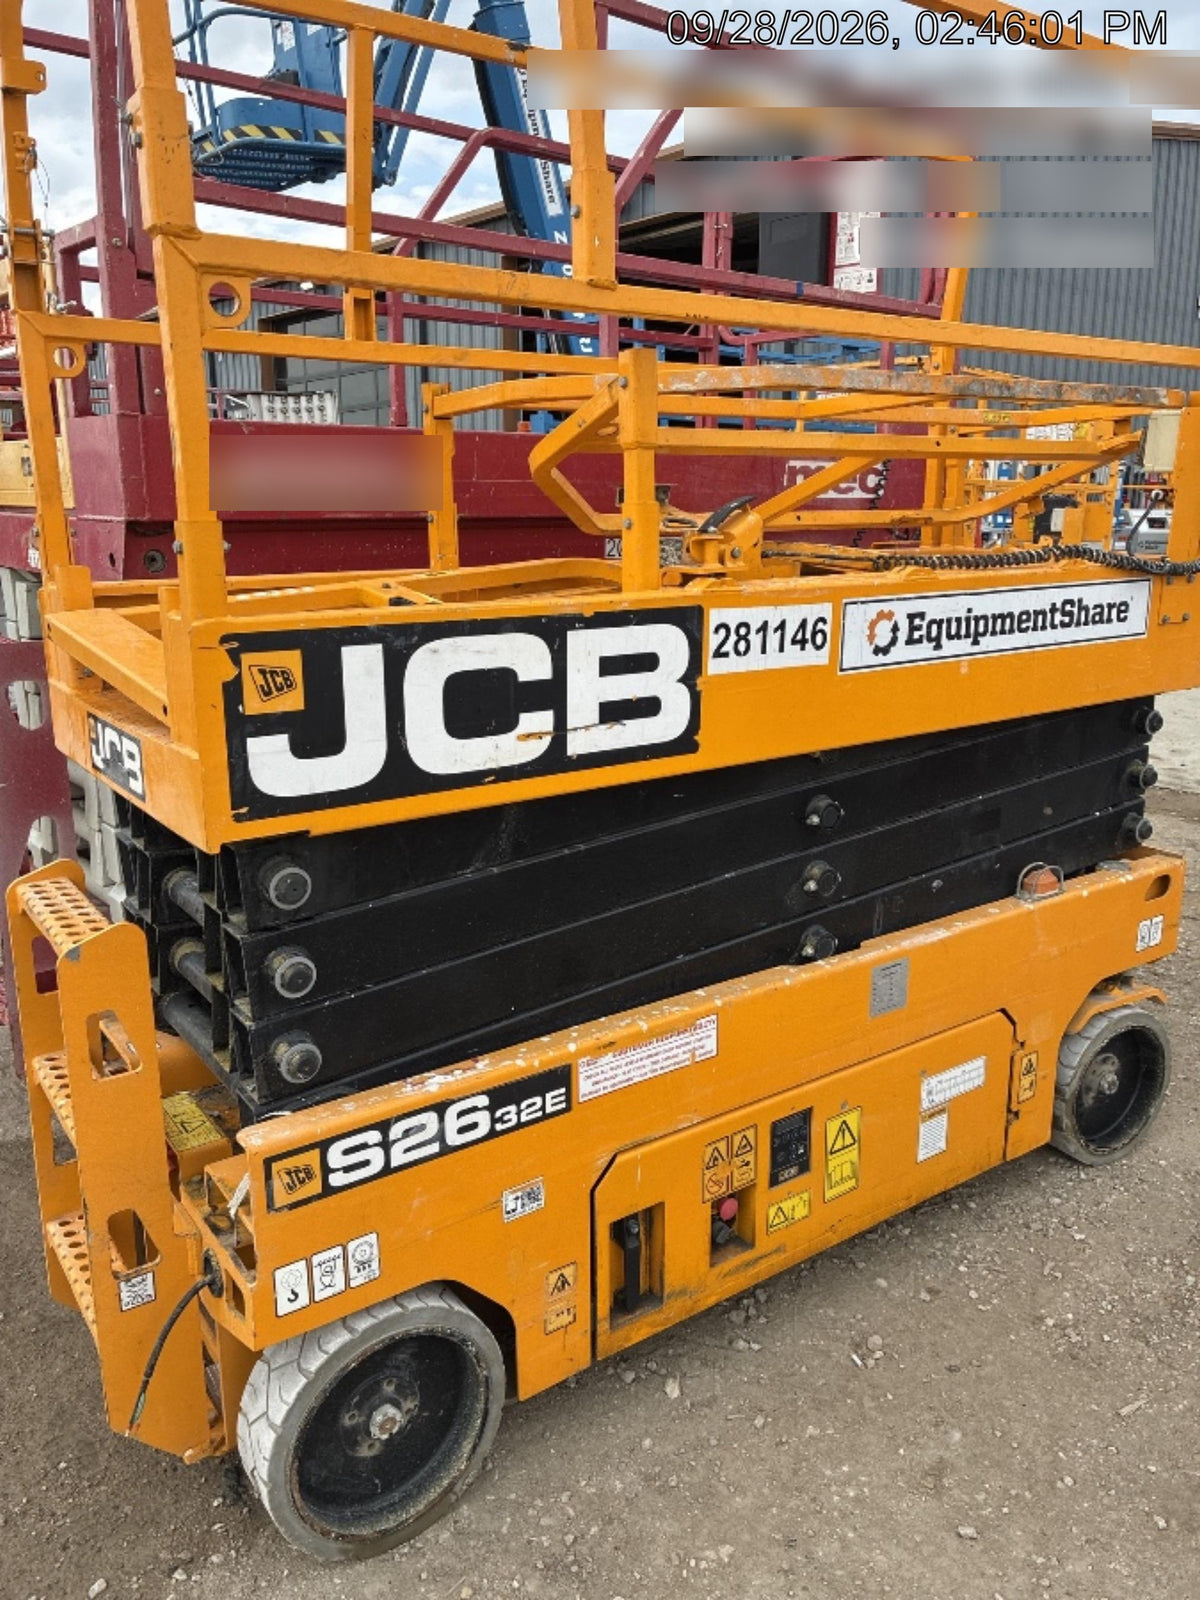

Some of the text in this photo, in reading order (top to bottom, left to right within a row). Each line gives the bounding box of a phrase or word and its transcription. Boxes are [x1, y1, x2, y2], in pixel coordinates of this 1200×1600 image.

[711, 616, 828, 659] 281146
[904, 599, 1130, 650] EquipmentShare
[257, 667, 294, 698] JCB
[247, 623, 691, 797] JCB
[285, 1165, 314, 1192] JCB
